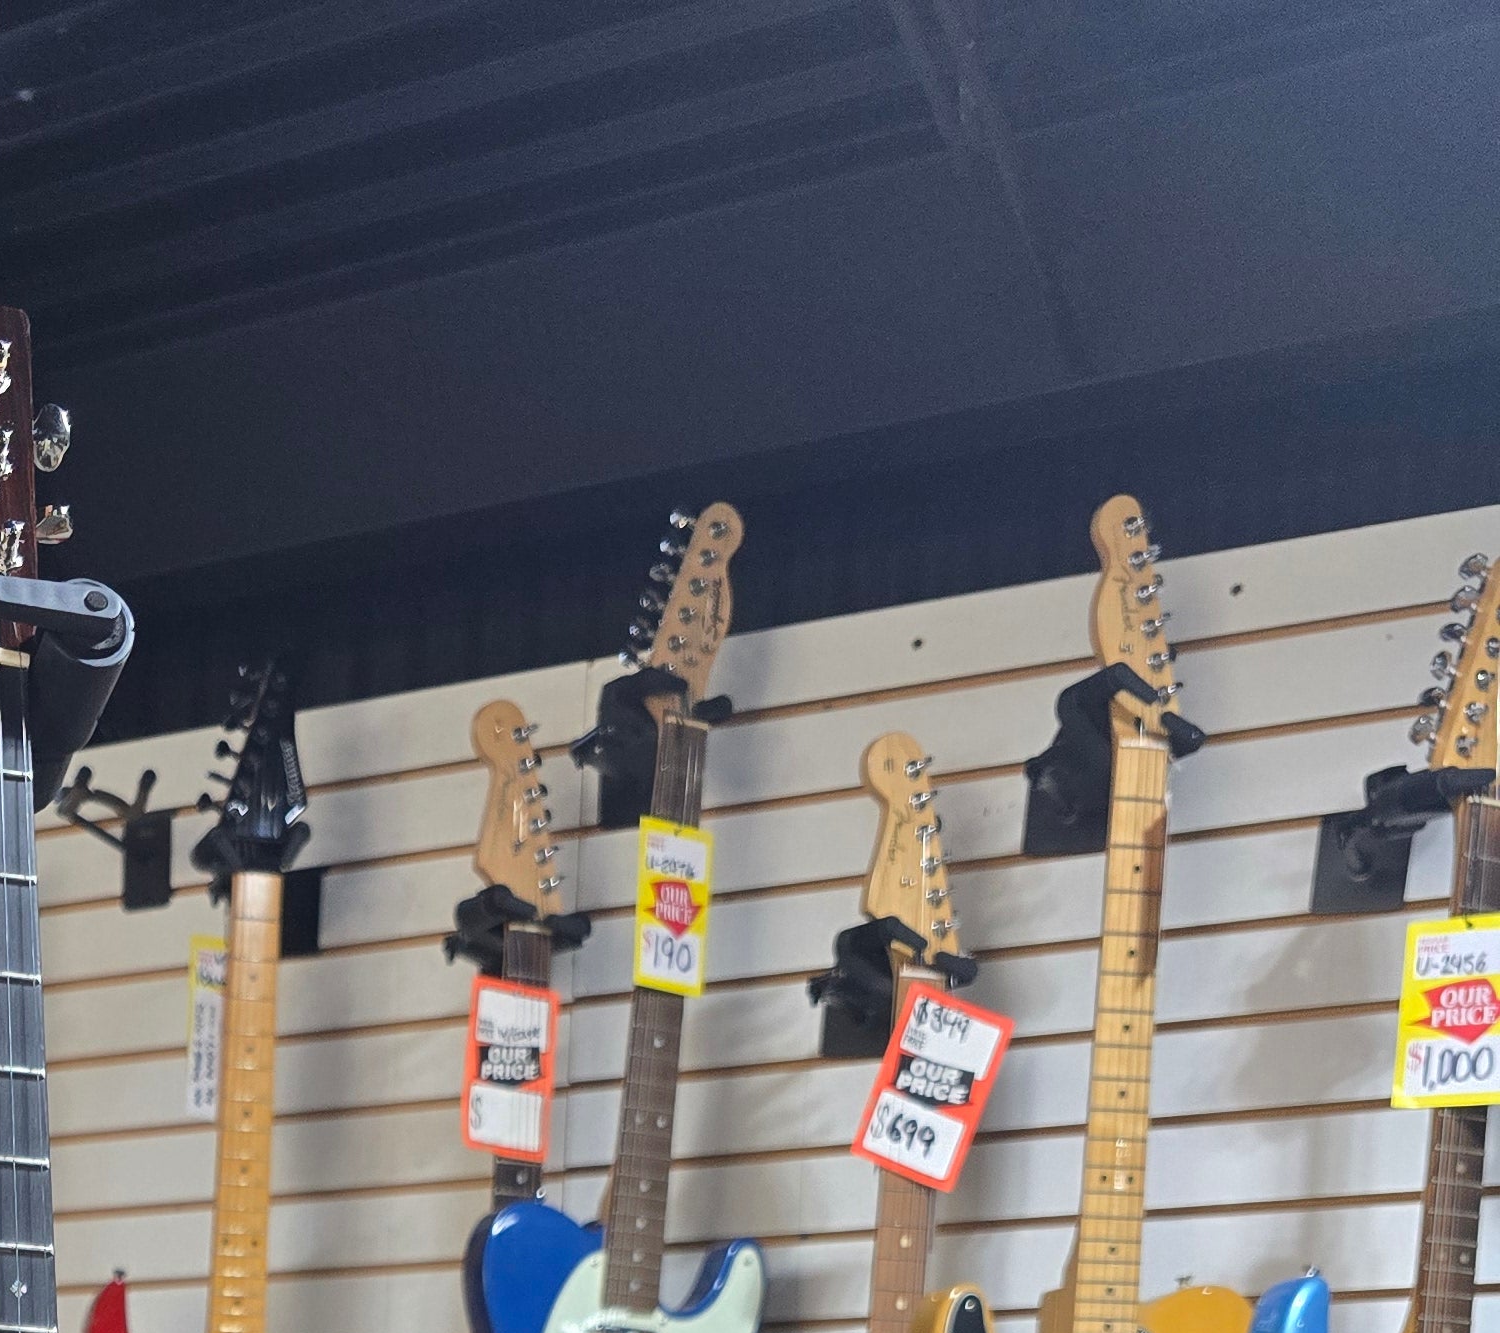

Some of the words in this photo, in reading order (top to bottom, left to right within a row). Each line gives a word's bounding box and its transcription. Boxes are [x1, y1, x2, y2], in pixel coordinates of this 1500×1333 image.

[660, 884, 688, 905] OUR
[655, 902, 692, 925] PRICE
[1440, 985, 1493, 1009] OUR
[1431, 1005, 1500, 1028] PRICE
[487, 1046, 531, 1065] OUR
[480, 1061, 540, 1081] PRICE
[910, 1057, 964, 1085] OUR
[896, 1068, 969, 1105] PRICE
[871, 1103, 935, 1160] $699
